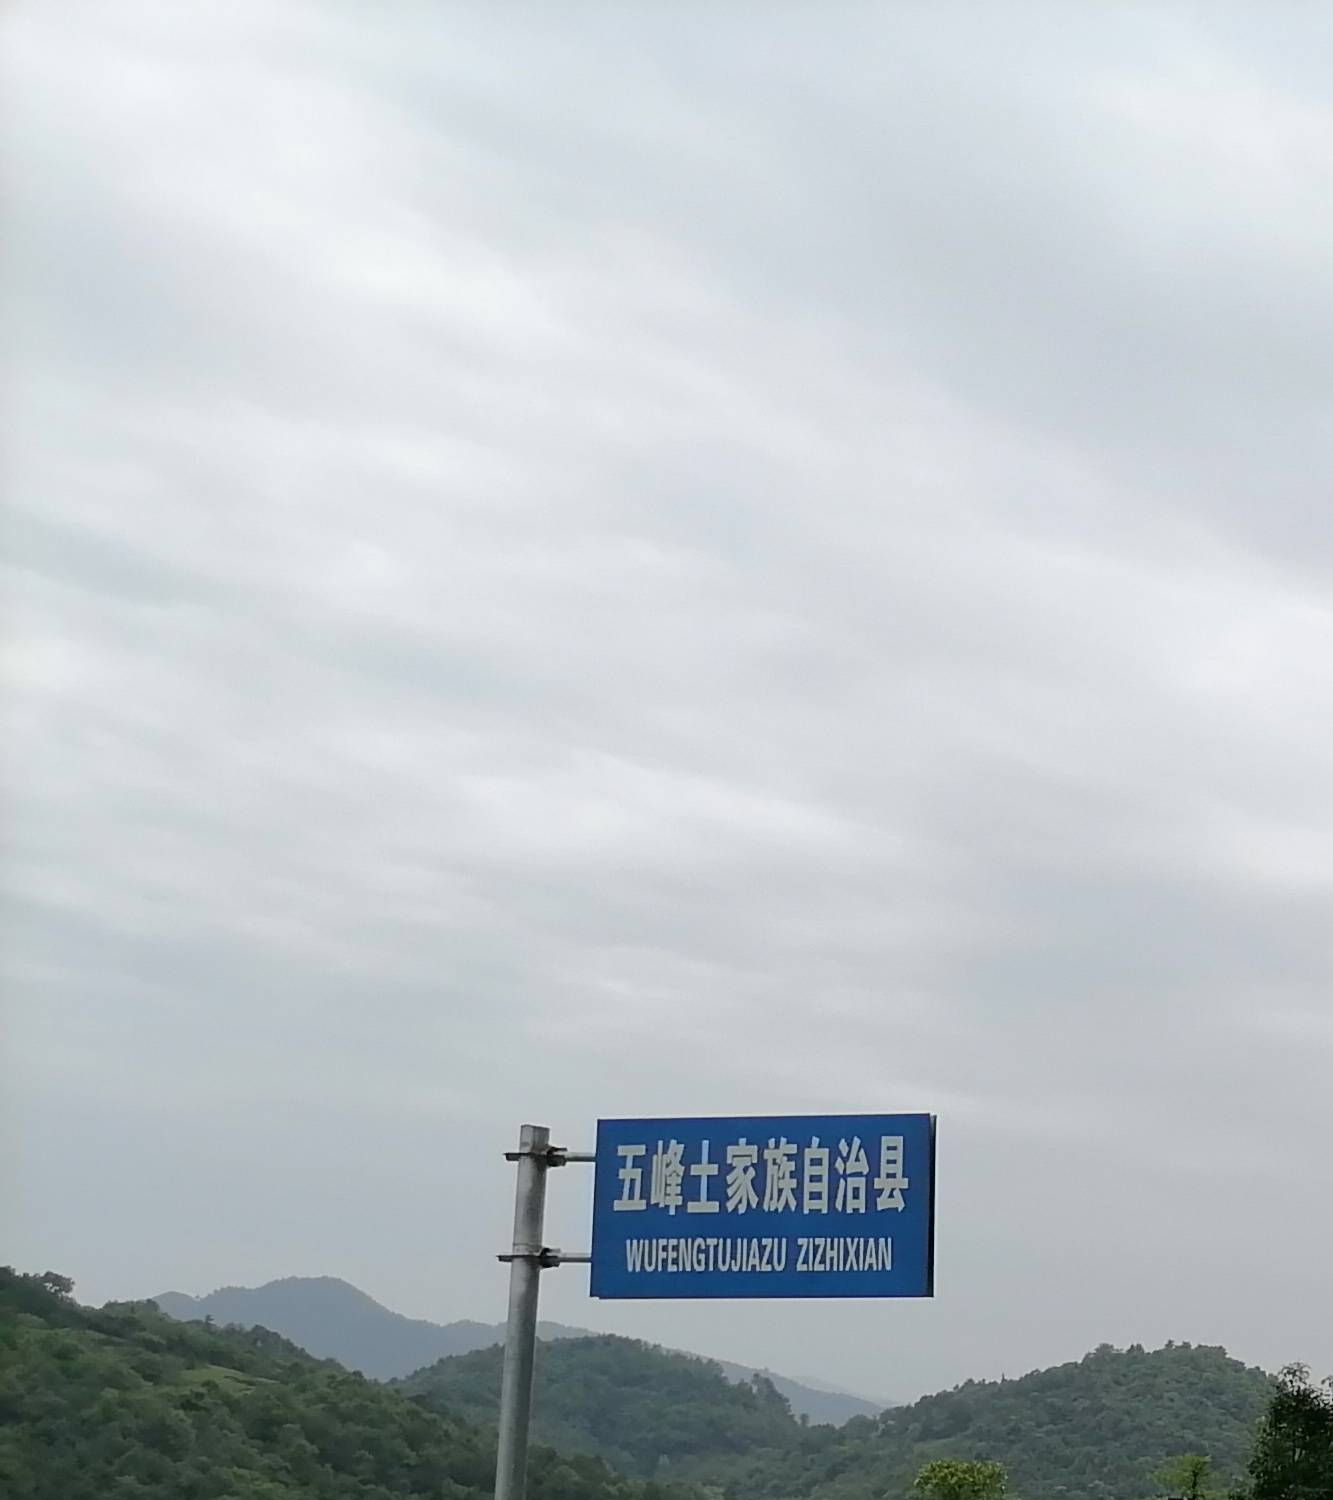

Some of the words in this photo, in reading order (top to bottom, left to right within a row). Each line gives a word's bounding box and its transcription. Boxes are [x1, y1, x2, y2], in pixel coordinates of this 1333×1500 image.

[613, 1136, 909, 1215] 五峰土家族自治县
[626, 1238, 787, 1272] WUFENGTUJIAZU
[796, 1237, 892, 1271] ZIZHIXIAN
